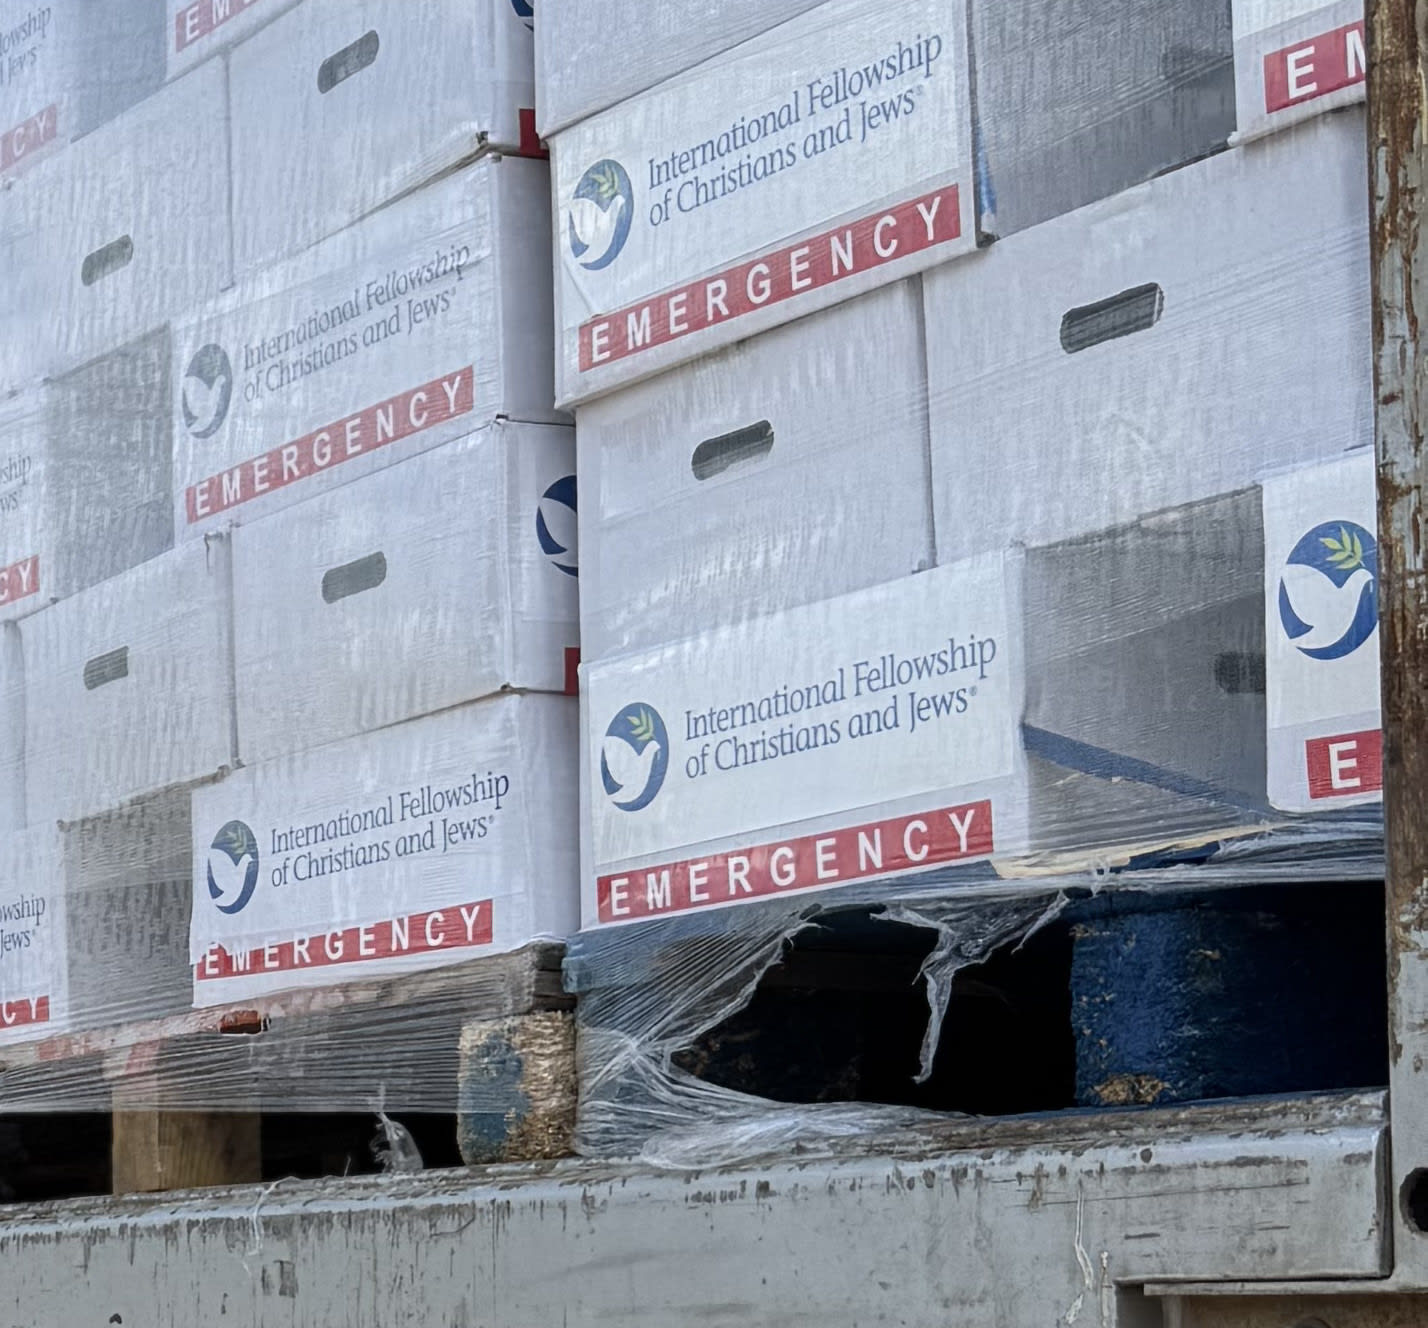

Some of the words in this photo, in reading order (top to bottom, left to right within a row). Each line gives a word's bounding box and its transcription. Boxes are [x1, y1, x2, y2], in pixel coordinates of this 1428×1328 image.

[647, 93, 801, 192] International
[806, 32, 942, 118] Fellowship
[649, 186, 673, 227] of
[675, 130, 798, 215] Christians
[803, 108, 856, 158] and
[245, 295, 361, 368] International
[364, 244, 470, 312] Fellowship
[591, 198, 943, 362] EMERGENCY
[245, 367, 263, 402] of
[265, 328, 358, 392] Christians
[361, 311, 401, 347] and
[195, 381, 463, 518] EMERGENCY
[684, 667, 845, 739] International
[850, 634, 998, 698] Fellowship
[685, 742, 711, 783] of
[713, 719, 842, 772] Christians
[847, 701, 900, 744] and
[271, 803, 393, 855] International
[397, 770, 509, 825] Fellowship
[272, 857, 290, 889] of
[294, 830, 389, 881] Christians
[393, 821, 435, 857] and
[611, 809, 976, 917] EMERGENCY
[204, 904, 484, 976] EMERGENCY
